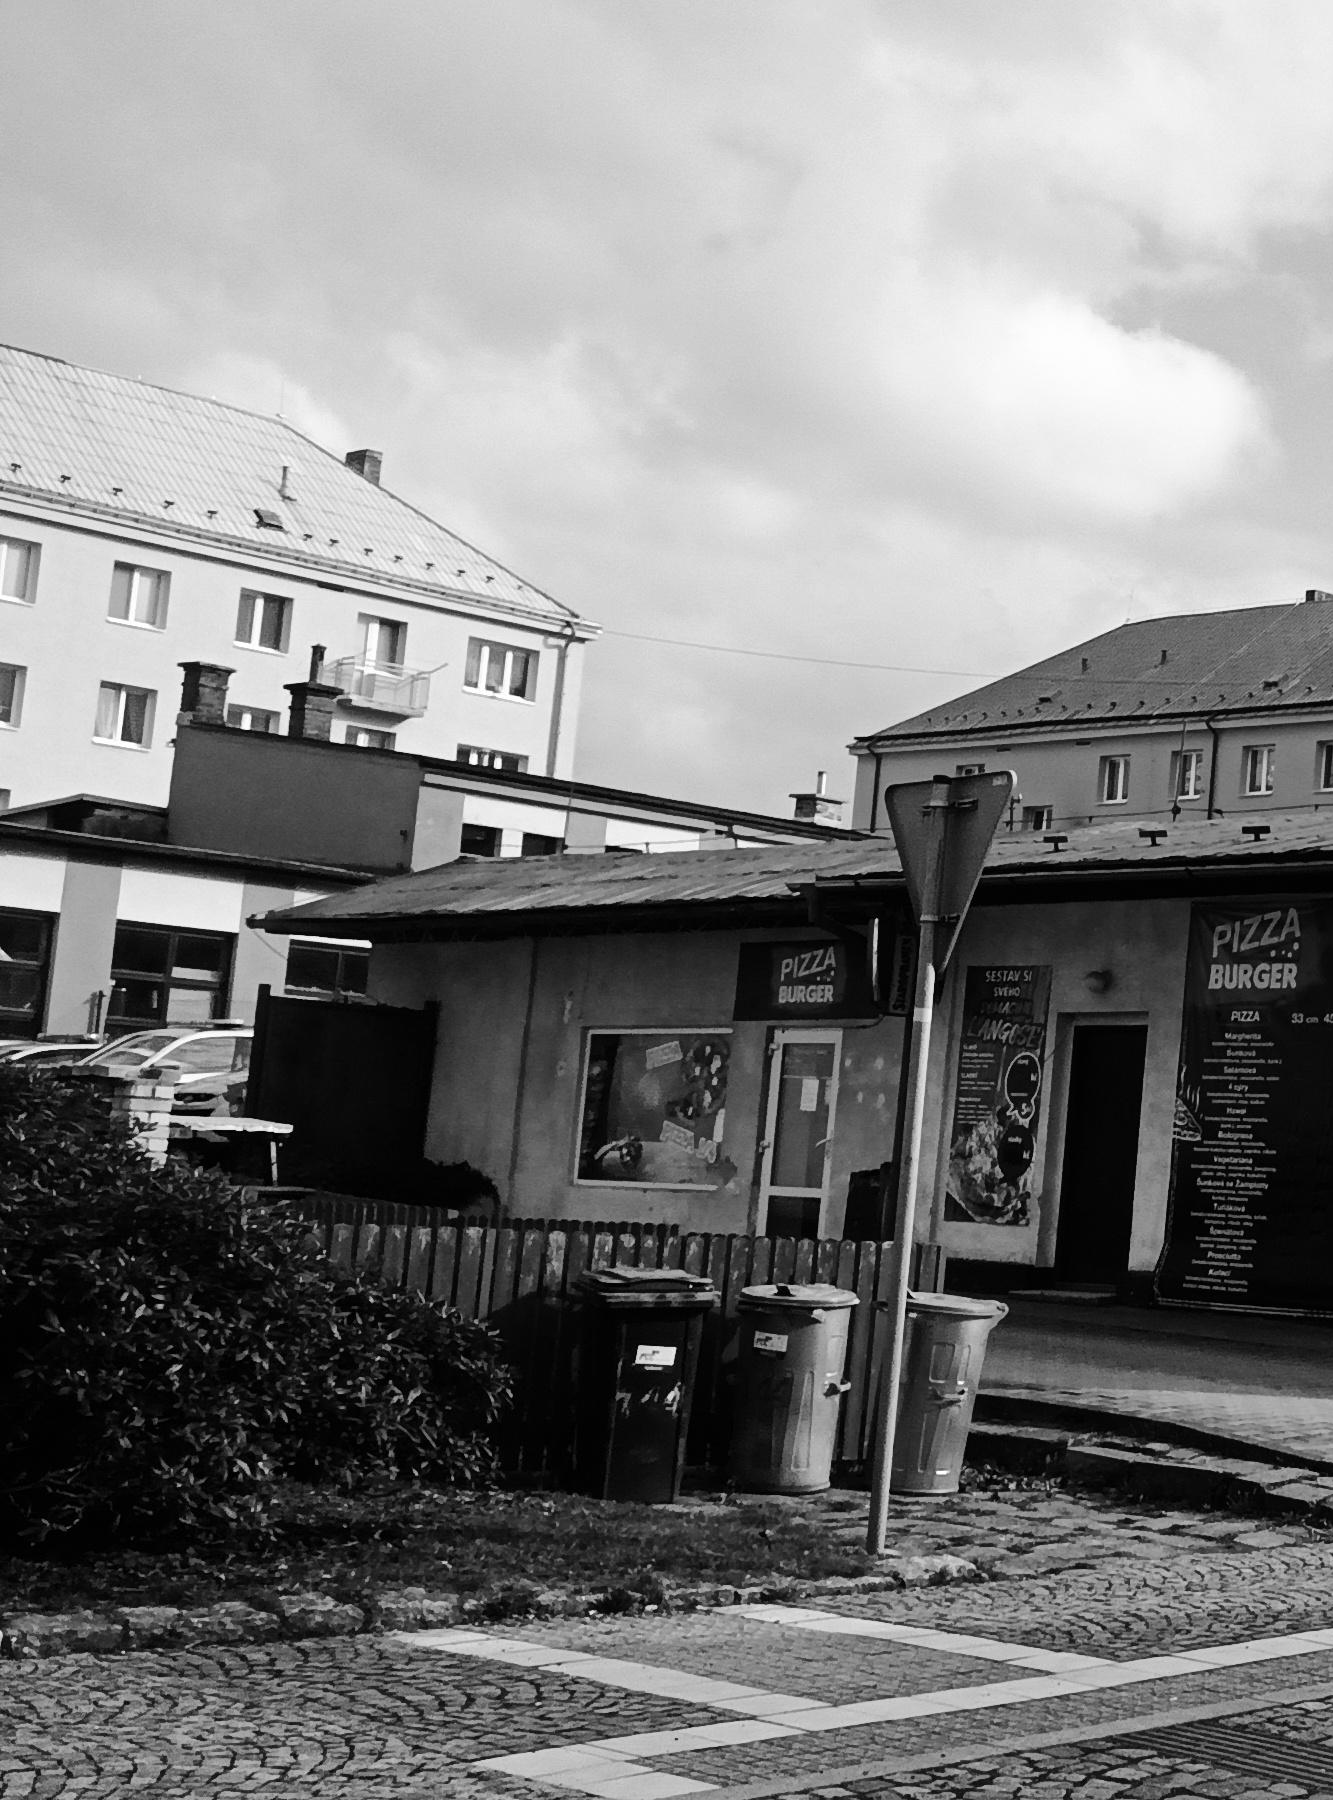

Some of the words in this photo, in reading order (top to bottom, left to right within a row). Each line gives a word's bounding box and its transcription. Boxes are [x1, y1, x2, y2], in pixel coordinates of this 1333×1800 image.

[1212, 907, 1301, 958] PIZZA
[780, 945, 837, 982] PIZZA
[985, 969, 1021, 983] SESTAV
[1023, 969, 1033, 982] SI
[1207, 962, 1298, 990] BURGER
[778, 984, 834, 1004] BURGER
[1230, 1010, 1260, 1022] PIZZA
[1290, 1012, 1304, 1024] 33
[1306, 1016, 1319, 1024] cm
[1224, 1032, 1262, 1042] Margherita
